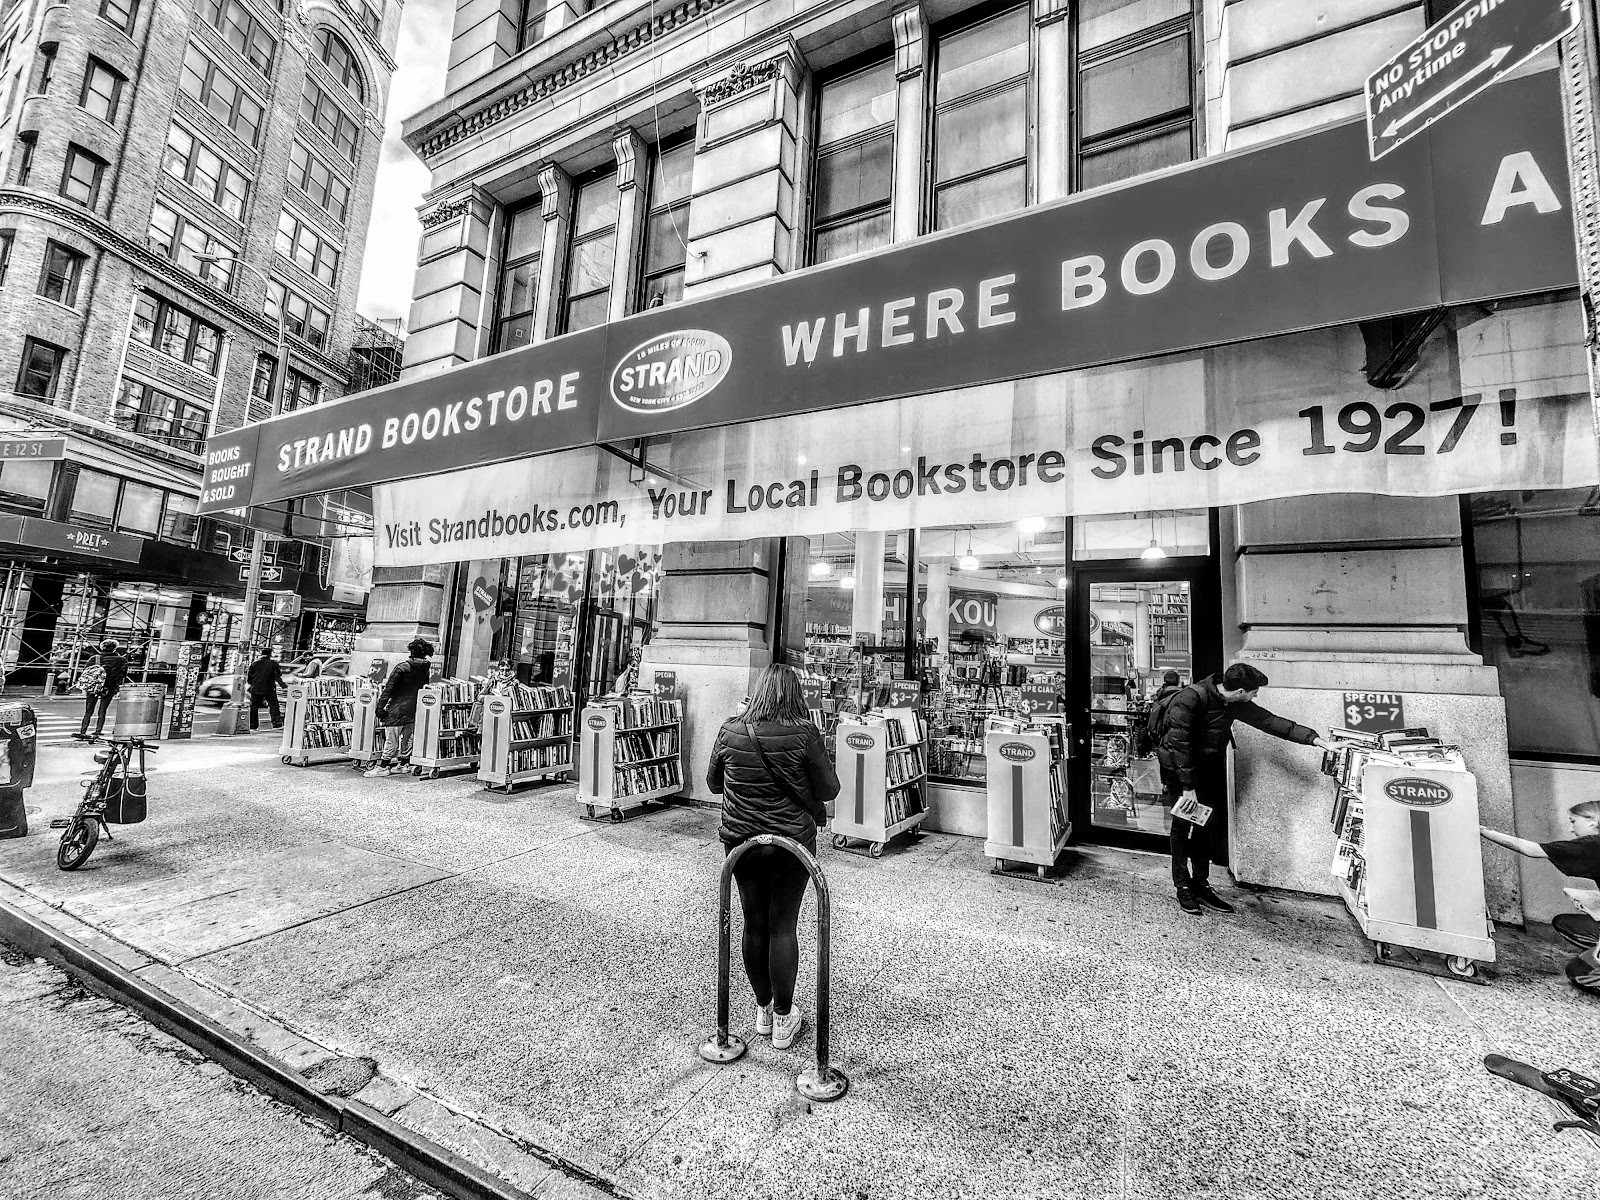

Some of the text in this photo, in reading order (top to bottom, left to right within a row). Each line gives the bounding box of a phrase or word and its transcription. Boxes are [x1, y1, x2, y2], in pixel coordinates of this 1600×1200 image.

[1375, 63, 1404, 95] NO
[1378, 41, 1467, 114] Anytime
[781, 273, 1017, 367] WHERE
[1060, 182, 1411, 311] BOOKS
[619, 350, 722, 392] STRAND
[277, 371, 581, 473] STRAND BOOKSTORE
[3, 442, 43, 456] E 12 St
[208, 446, 241, 466] BOOKS
[210, 462, 252, 484] BOUGHT
[385, 388, 1518, 549] Visit Strandbooks.com, Your Local Bookstore Since 1927!
[209, 485, 235, 502] SOLD
[75, 531, 102, 547] PRET
[654, 671, 675, 679] SPECIAL
[800, 679, 821, 687] PECIAL
[654, 683, 674, 695] $3-7
[893, 681, 919, 691] SPECIAL
[1022, 685, 1055, 694] SPECIAL
[891, 691, 919, 707] $3-7
[1021, 699, 1054, 715] $3-7
[1345, 693, 1399, 705] SPECIAL
[588, 719, 607, 727] STRAND
[1346, 704, 1400, 726] $3-7
[847, 737, 875, 747] STRAND
[1001, 747, 1034, 758] STRAND
[1389, 785, 1449, 800] STRAND
